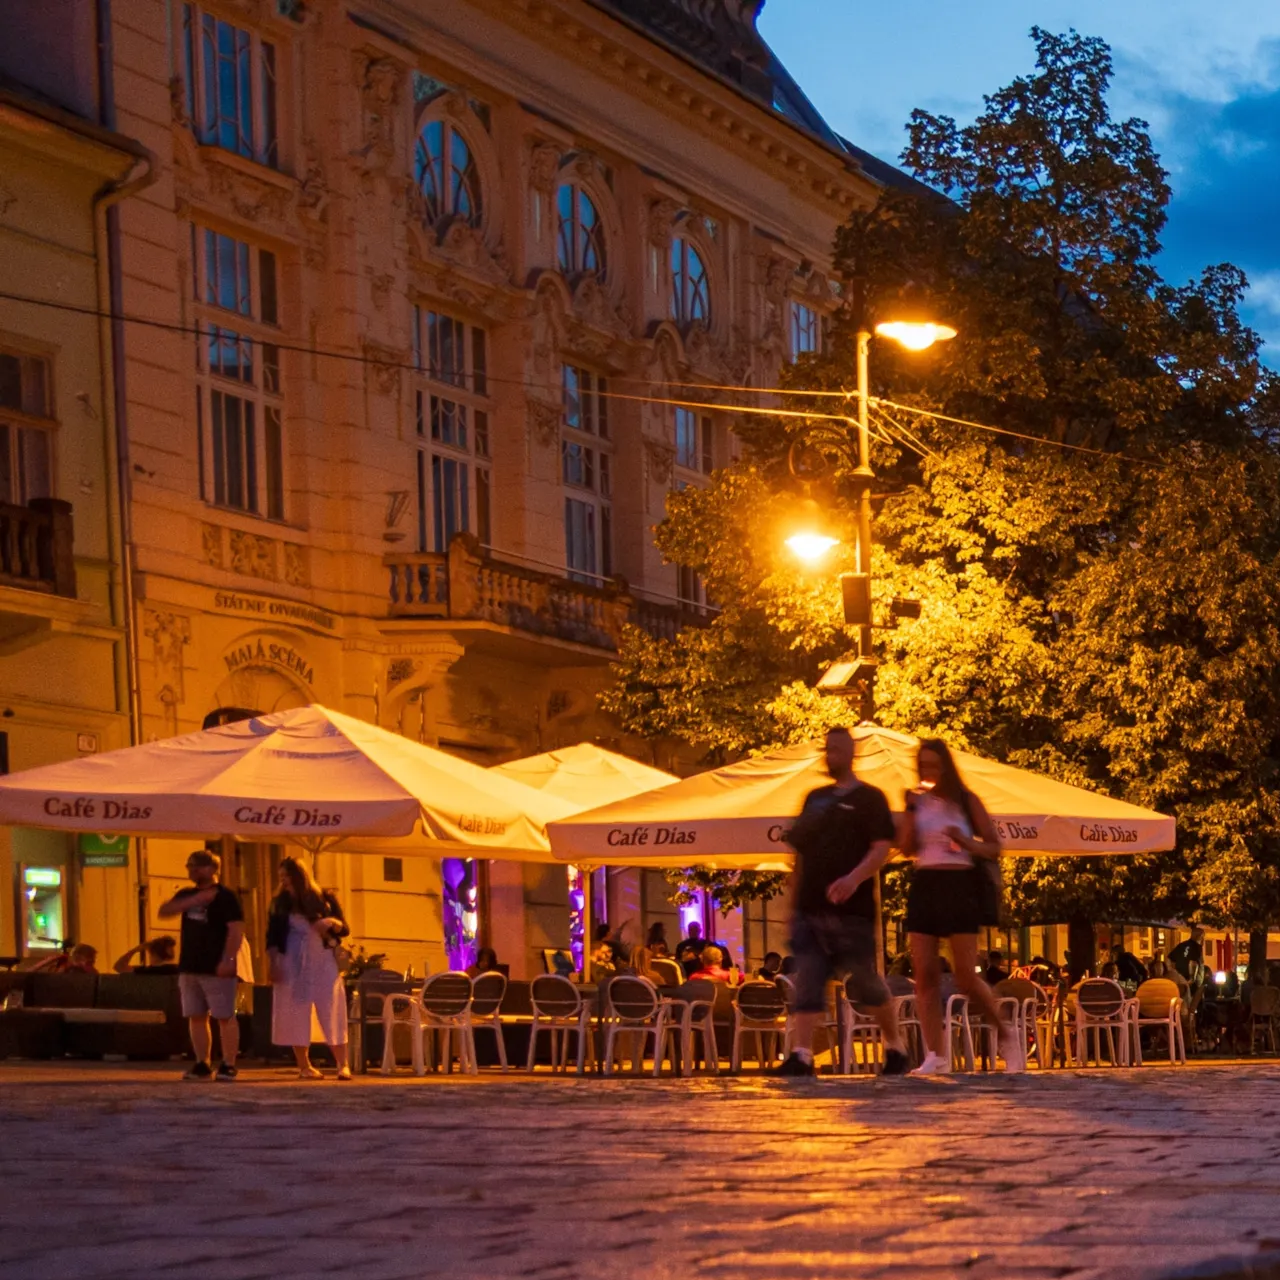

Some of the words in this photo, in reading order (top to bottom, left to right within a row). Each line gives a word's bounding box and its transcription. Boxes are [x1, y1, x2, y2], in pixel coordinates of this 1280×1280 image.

[224, 638, 266, 672] MALÁ
[43, 797, 95, 818] Café
[102, 800, 153, 819] Dias
[234, 805, 287, 826] Café
[291, 808, 342, 827] Dias
[458, 814, 483, 833] Café
[484, 817, 505, 835] Dias
[1006, 821, 1039, 839] Dias
[1079, 823, 1109, 842] Café
[1108, 826, 1138, 843] Dias
[607, 826, 650, 846] Café
[653, 827, 697, 845] Dias
